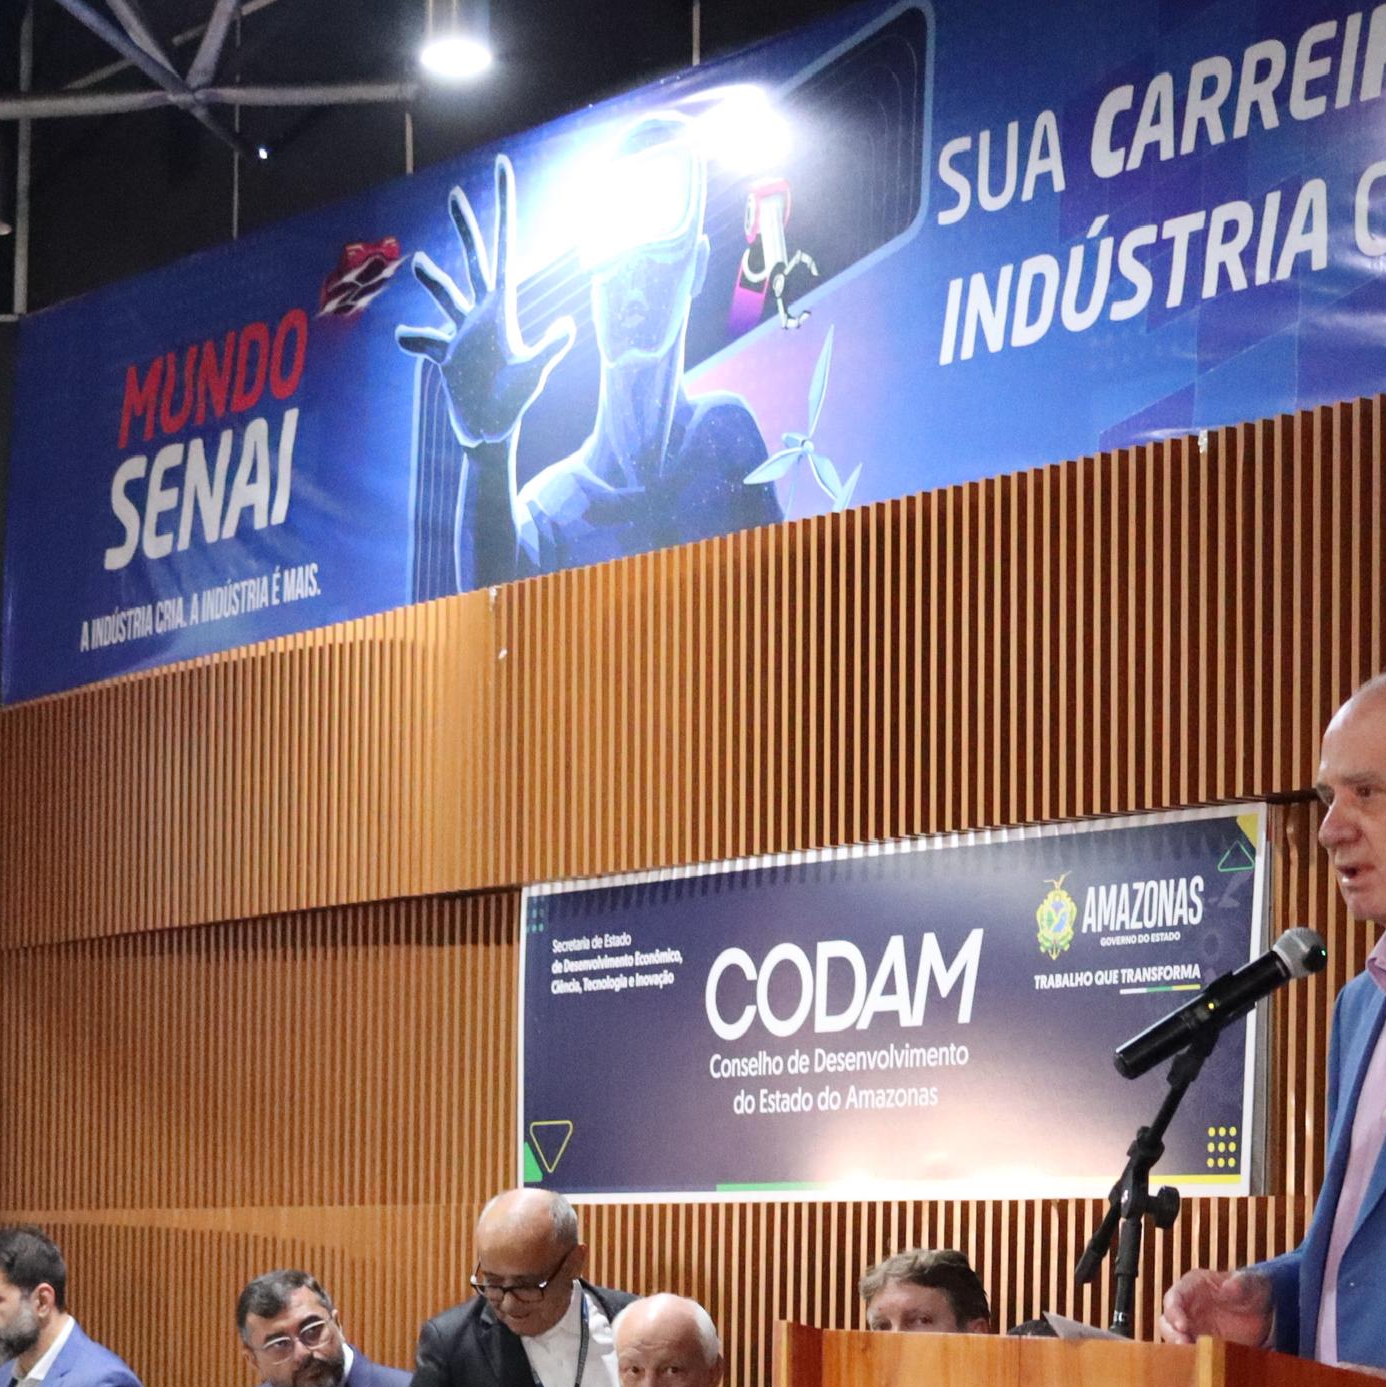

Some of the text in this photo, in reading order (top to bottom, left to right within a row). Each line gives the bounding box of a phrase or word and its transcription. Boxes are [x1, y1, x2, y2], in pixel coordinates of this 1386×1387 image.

[937, 110, 1066, 225] SUA
[939, 178, 1328, 366] INDÚSTRIA
[117, 309, 308, 450] MUNDO
[104, 408, 299, 571] SENAI
[80, 562, 322, 652] A INDÚSTRIA CRIA. A INDÚSTRIA É MAIS.
[591, 935, 603, 949] de
[604, 932, 631, 948] Estado
[1081, 875, 1205, 933] AMAZONAS
[1100, 931, 1181, 947] GOVERNO DO ESTADO
[705, 928, 984, 1041] CODAM
[1034, 963, 1201, 990] TRABALHO QUE TRANSFORMA
[709, 1043, 969, 1079] Conselho de Desenvolvimento
[733, 1085, 938, 1114] do Estado do Amazonas
